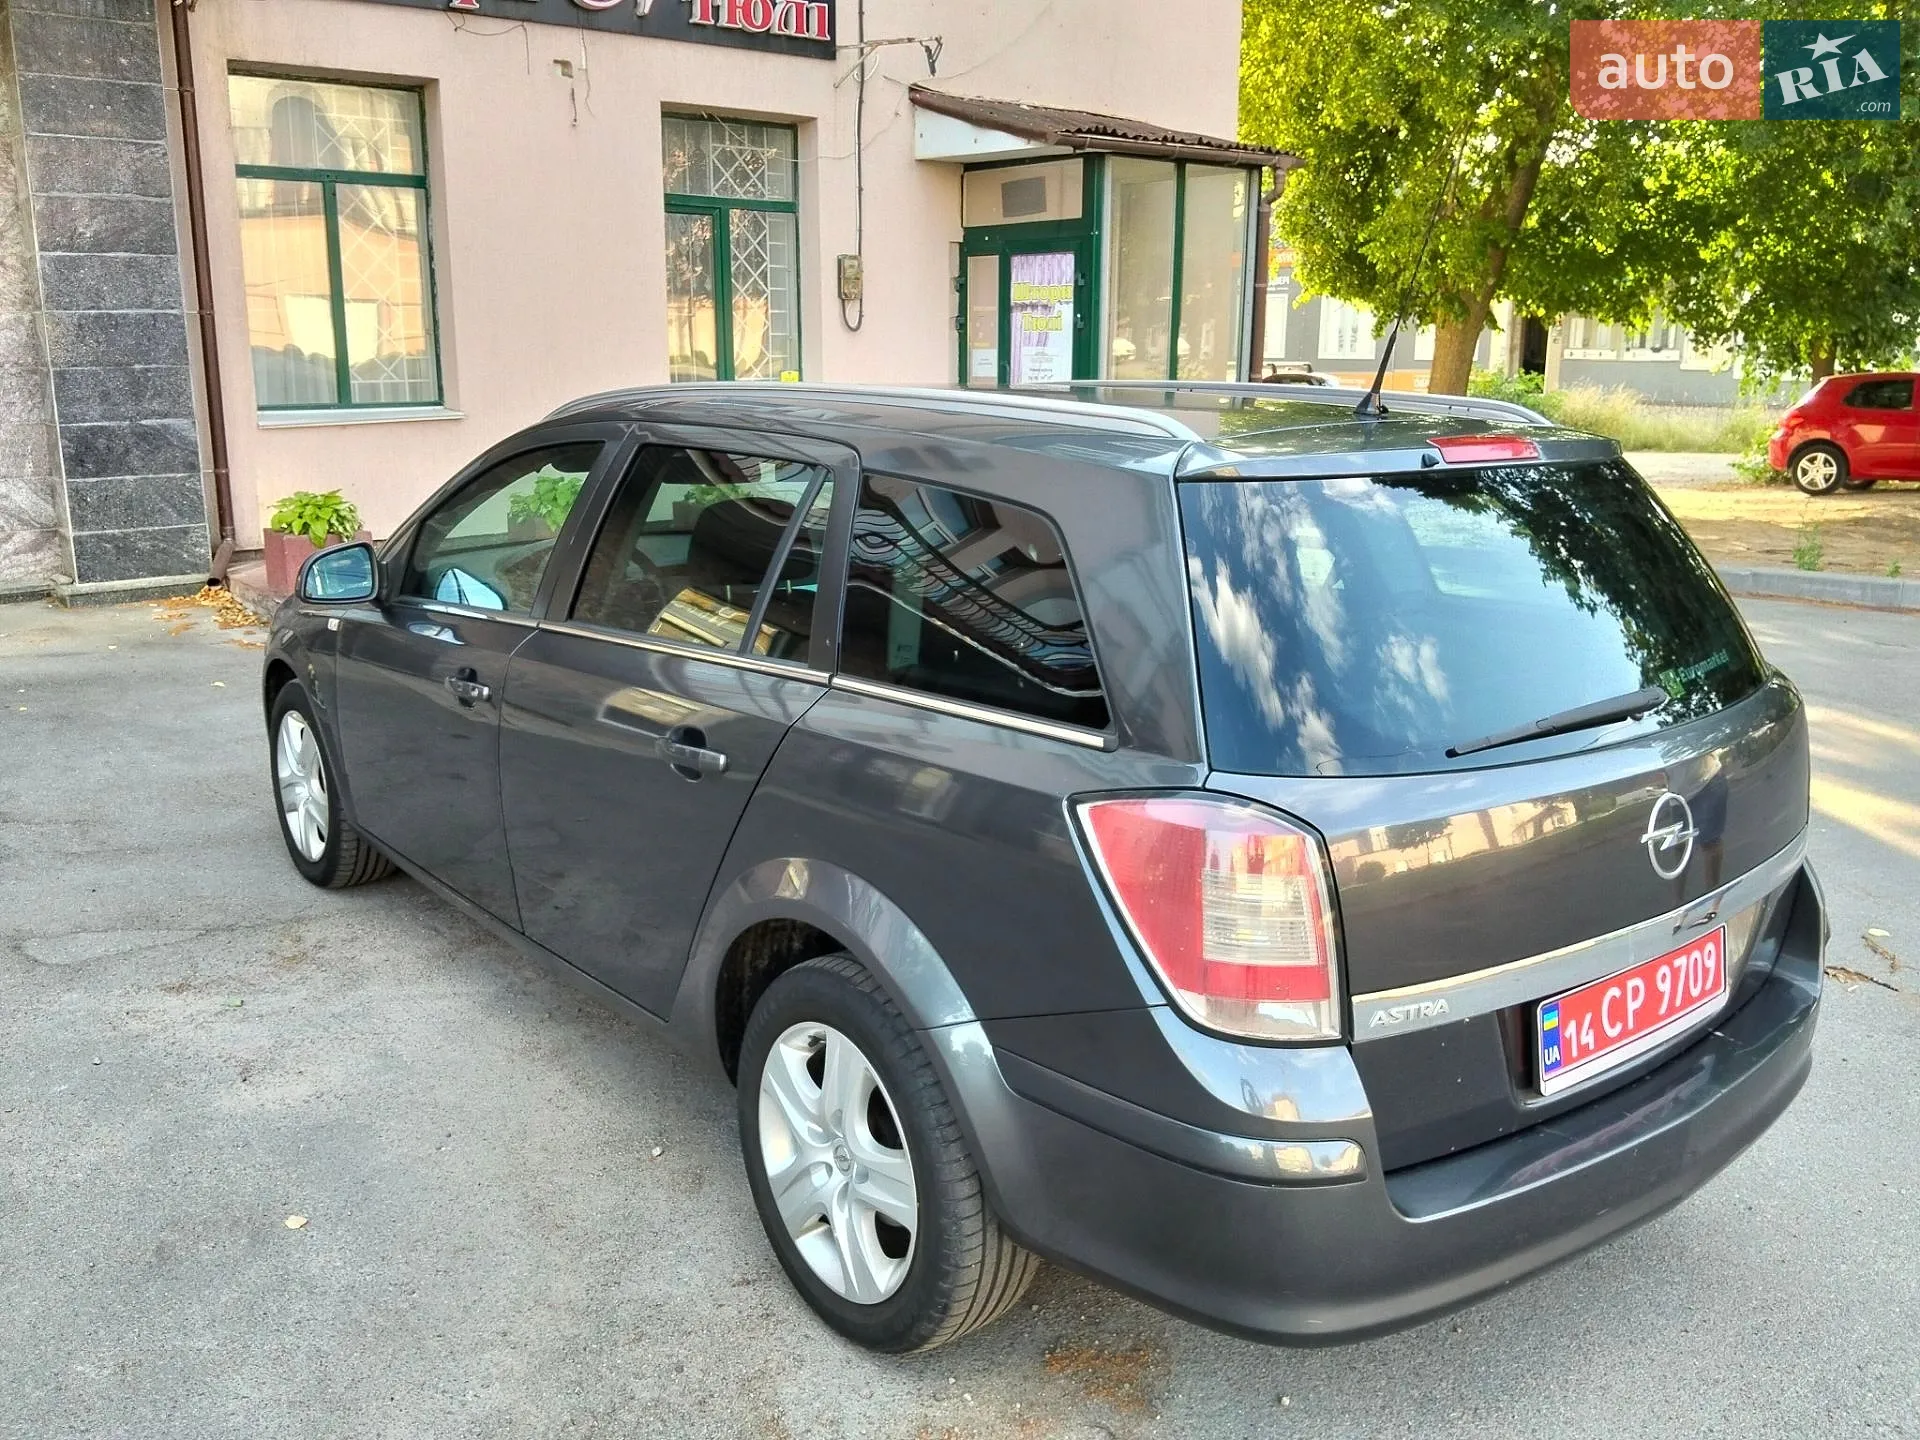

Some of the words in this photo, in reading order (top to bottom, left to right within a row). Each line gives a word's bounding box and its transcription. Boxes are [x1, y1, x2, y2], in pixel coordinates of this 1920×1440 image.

[1369, 998, 1450, 1028] ASTRA
[1564, 1012, 1595, 1058] 14
[1601, 976, 1646, 1039] CP
[1656, 942, 1716, 1016] 9709
[1545, 1048, 1561, 1065] UA
